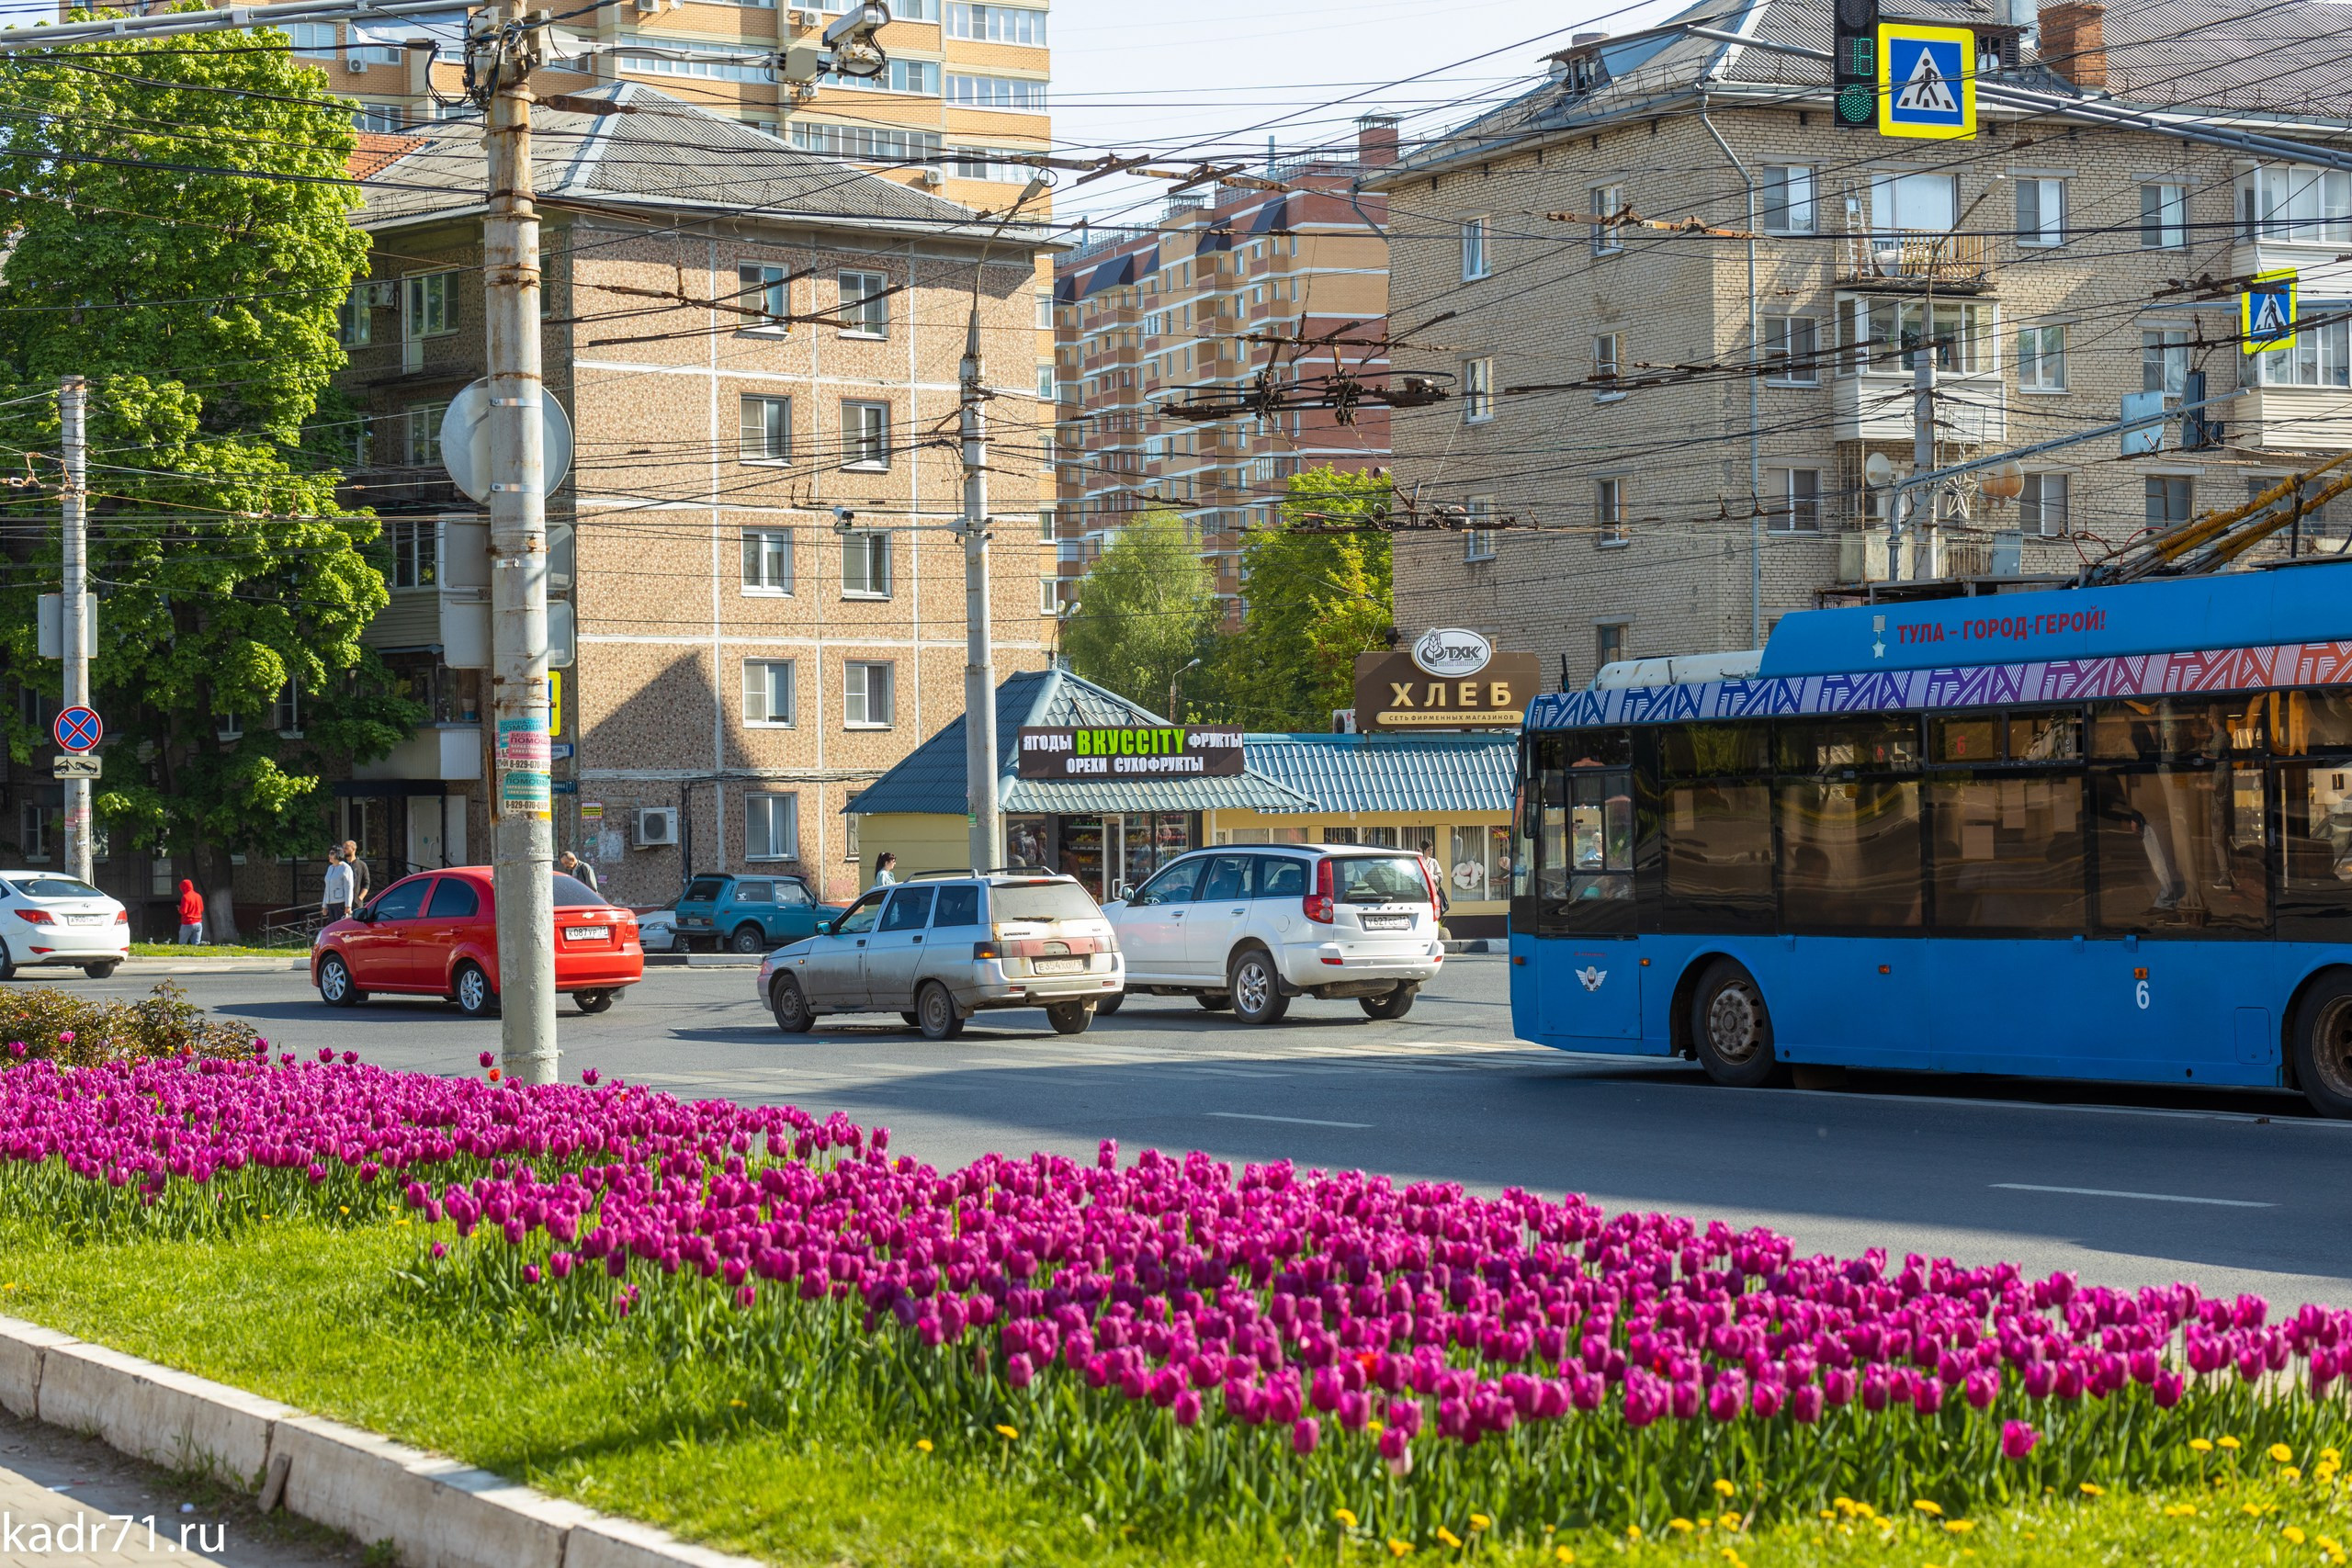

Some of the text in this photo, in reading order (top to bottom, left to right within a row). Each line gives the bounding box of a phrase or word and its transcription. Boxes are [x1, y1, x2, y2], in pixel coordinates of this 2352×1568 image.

[1896, 622, 1945, 644] ТУЛА
[1962, 604, 2107, 641] ГОРОД-ГЕРОЙ!
[1389, 682, 1511, 707] ХЛЕБ
[500, 724, 544, 733] ПОМОЩЬ
[1023, 735, 1072, 752] ЯГОДЫ
[1187, 732, 1243, 749] ФРУКТЫ
[1956, 735, 1966, 756] 6
[1066, 756, 1204, 773] ОРЕХИ СУХОФРУКТЫ
[506, 777, 548, 785] ПОМОЩЬ
[2135, 980, 2150, 1010] 6
